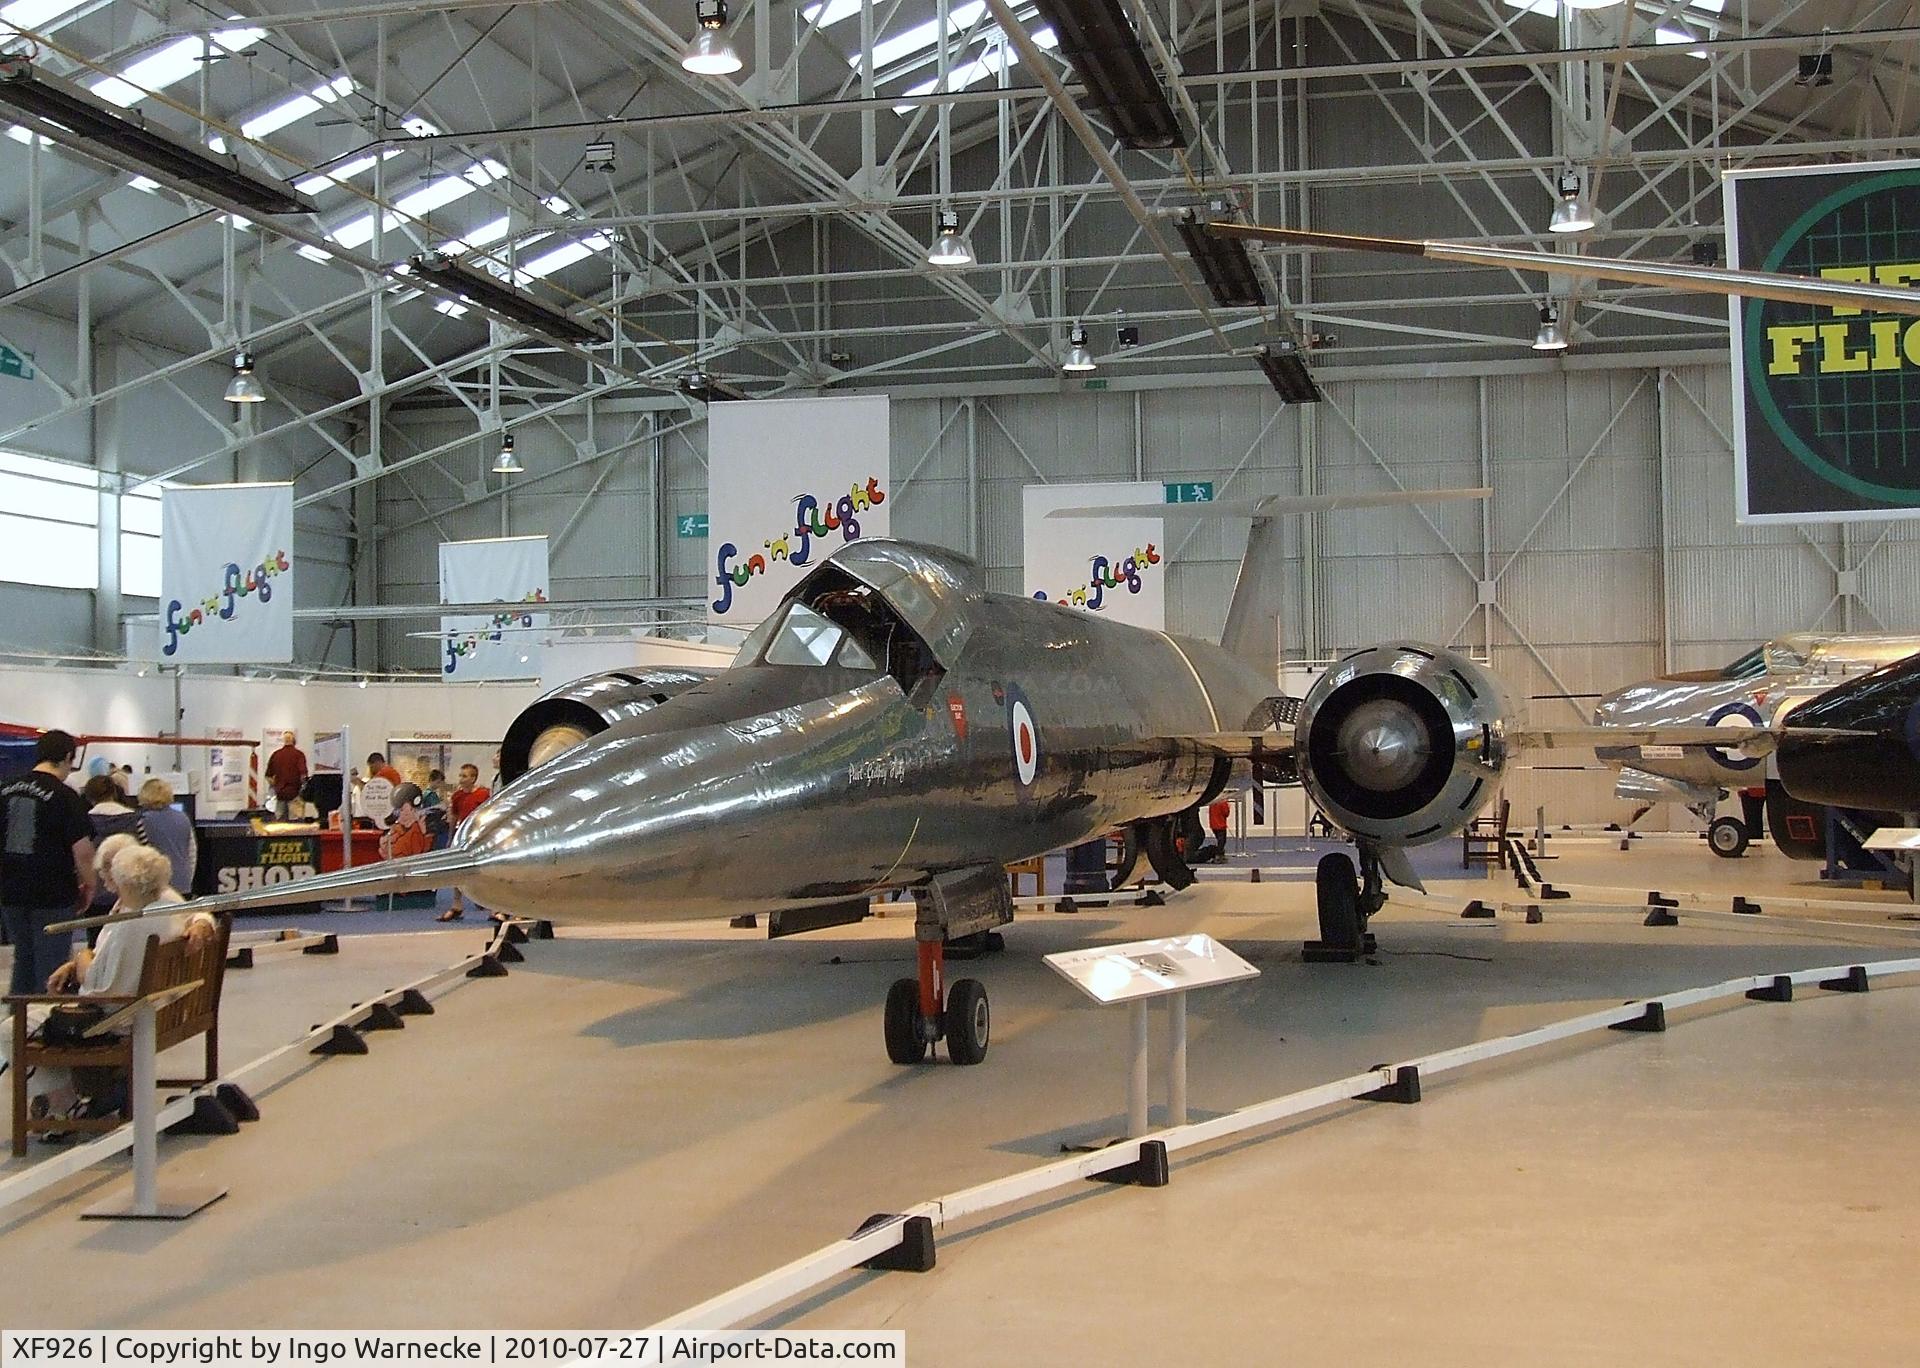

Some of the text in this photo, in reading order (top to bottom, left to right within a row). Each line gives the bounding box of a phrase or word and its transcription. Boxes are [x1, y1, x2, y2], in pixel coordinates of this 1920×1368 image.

[712, 543, 765, 614] fun
[789, 477, 885, 566] flight
[1086, 543, 1160, 610] flight
[162, 600, 202, 656] fun
[219, 550, 290, 620] flight
[260, 852, 311, 864] FLIGHT
[269, 842, 303, 854] TEST
[218, 865, 316, 893] SHOP
